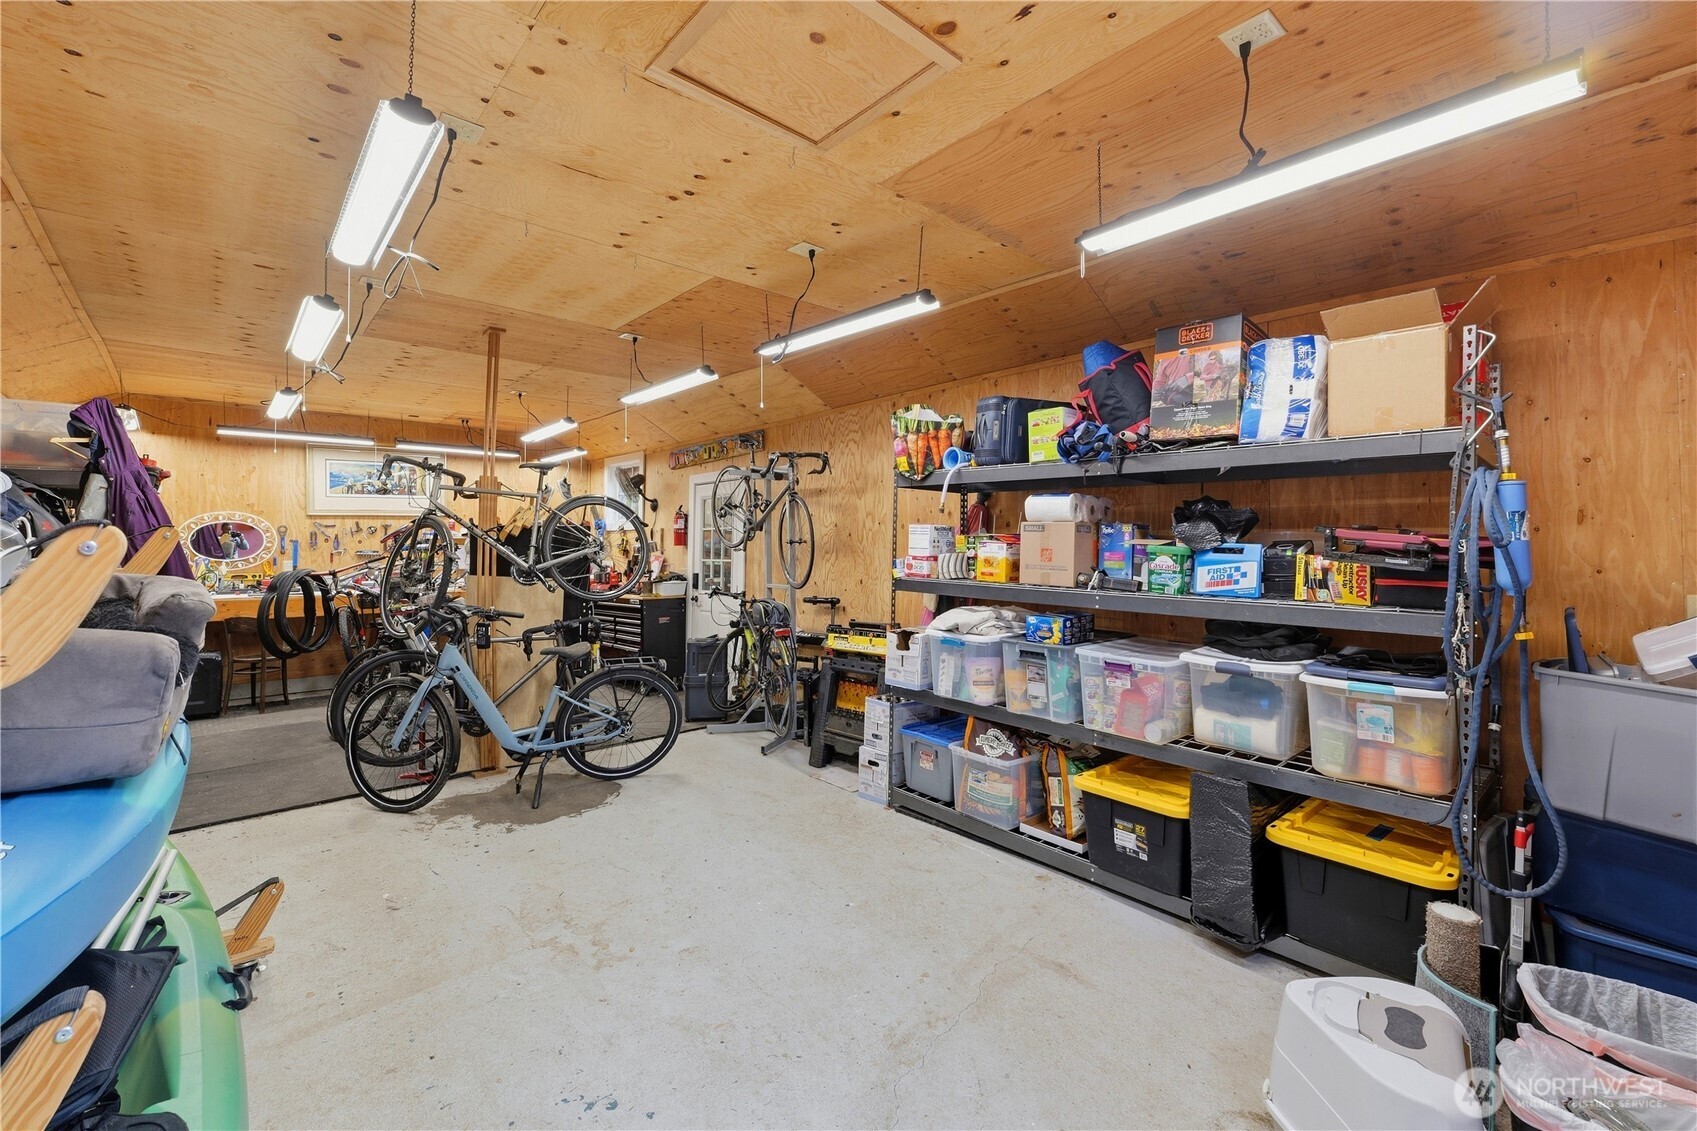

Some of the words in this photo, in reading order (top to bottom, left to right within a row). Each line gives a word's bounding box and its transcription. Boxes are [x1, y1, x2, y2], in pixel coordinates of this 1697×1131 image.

[1181, 326, 1210, 337] BLACK+
[1181, 332, 1211, 342] DECKER
[1149, 561, 1180, 570] Cascade
[1207, 566, 1234, 576] FIRST
[1209, 573, 1226, 581] AID
[1341, 579, 1349, 589] Up
